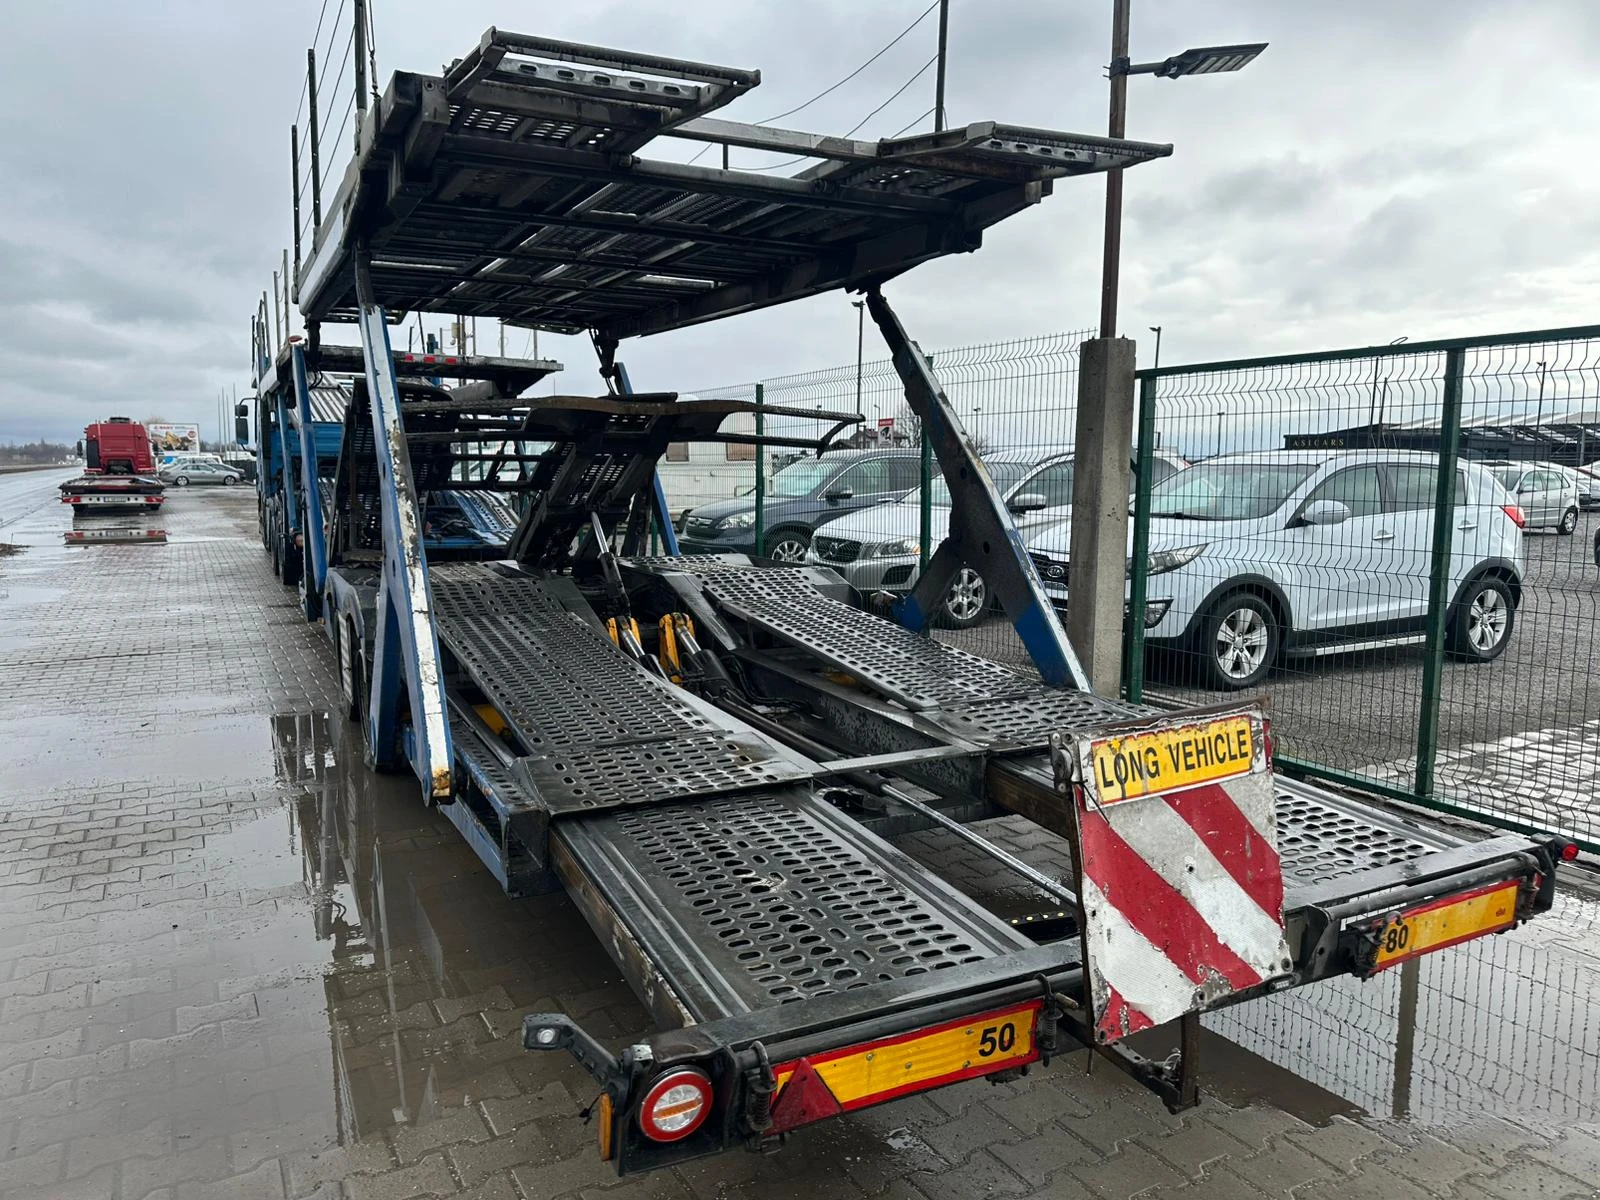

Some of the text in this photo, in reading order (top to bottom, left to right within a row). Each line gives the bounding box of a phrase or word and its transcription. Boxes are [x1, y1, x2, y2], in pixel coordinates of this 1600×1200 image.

[1099, 729, 1249, 789] LONG VEHICLE
[1385, 924, 1409, 954] 80
[978, 1022, 1016, 1057] 50
